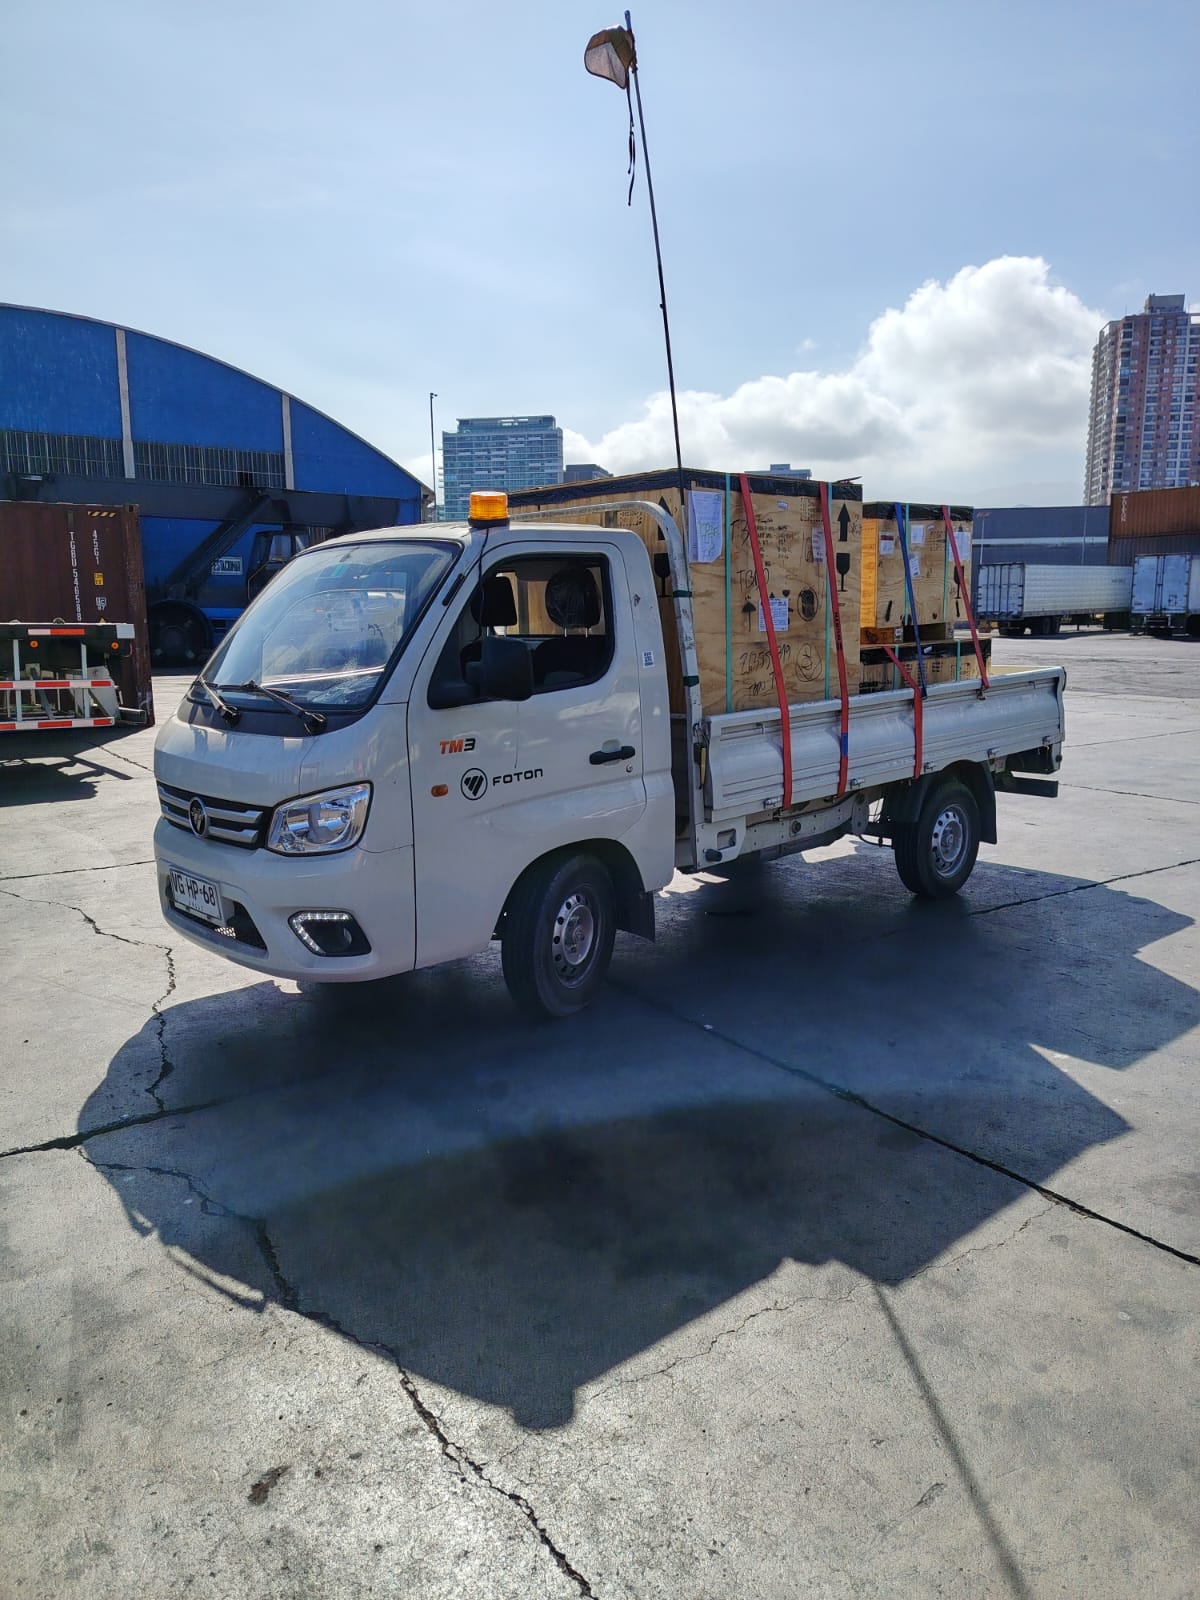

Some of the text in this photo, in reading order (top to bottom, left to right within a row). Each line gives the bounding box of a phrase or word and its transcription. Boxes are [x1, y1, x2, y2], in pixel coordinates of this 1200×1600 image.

[69, 531, 77, 567] TGBU
[92, 529, 100, 565] 45G1
[439, 738, 476, 754] TM3
[492, 768, 543, 786] FOTON
